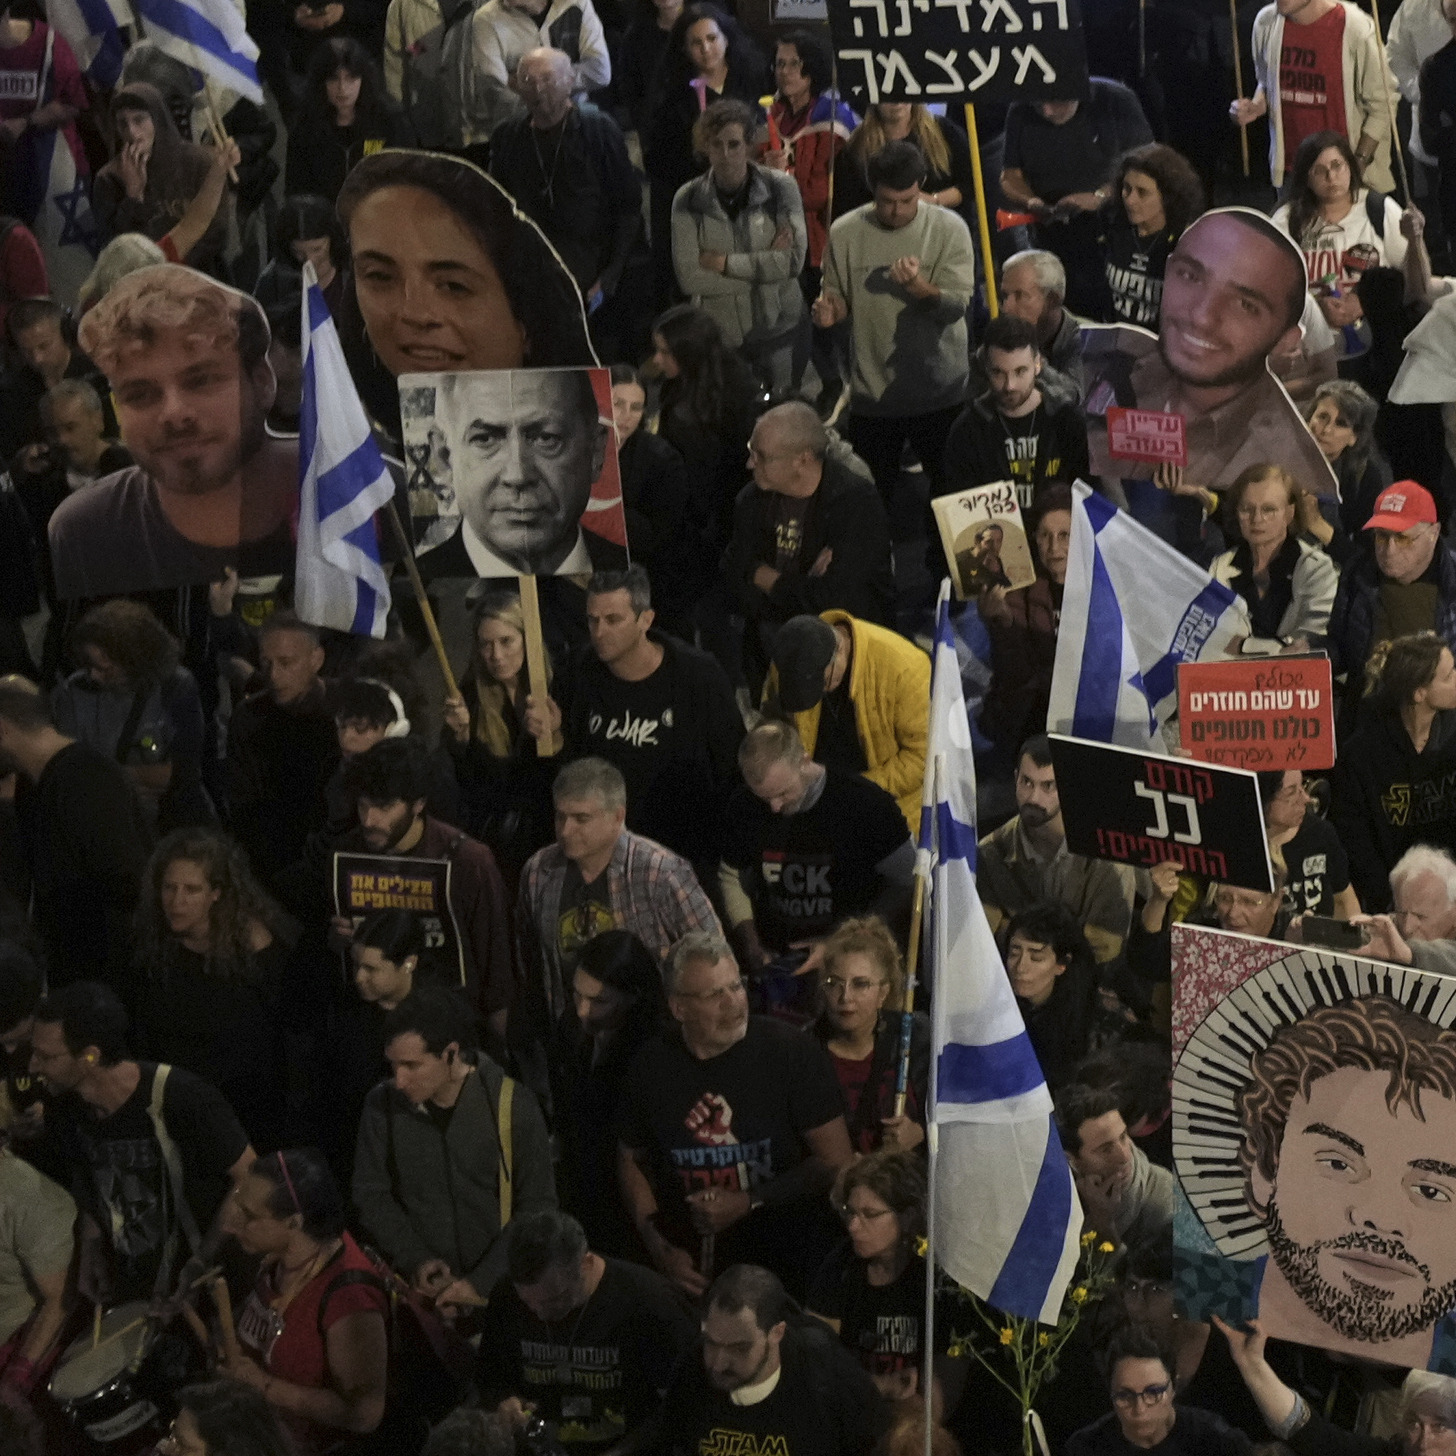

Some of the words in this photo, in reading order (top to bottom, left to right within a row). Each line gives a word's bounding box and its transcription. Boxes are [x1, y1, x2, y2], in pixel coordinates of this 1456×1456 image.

[1129, 414, 1179, 433] עדיין
[1120, 436, 1179, 453] בעזה.
[986, 500, 1016, 520] כהן
[1190, 690, 1247, 712] חוזרים
[1250, 690, 1293, 712] שהם
[1296, 689, 1320, 709] עד
[1190, 719, 1266, 743] חטופים
[1272, 717, 1320, 740] כולנו
[1144, 761, 1215, 804] קודם
[1133, 780, 1203, 846] כל
[1096, 827, 1228, 879] החטופים!
